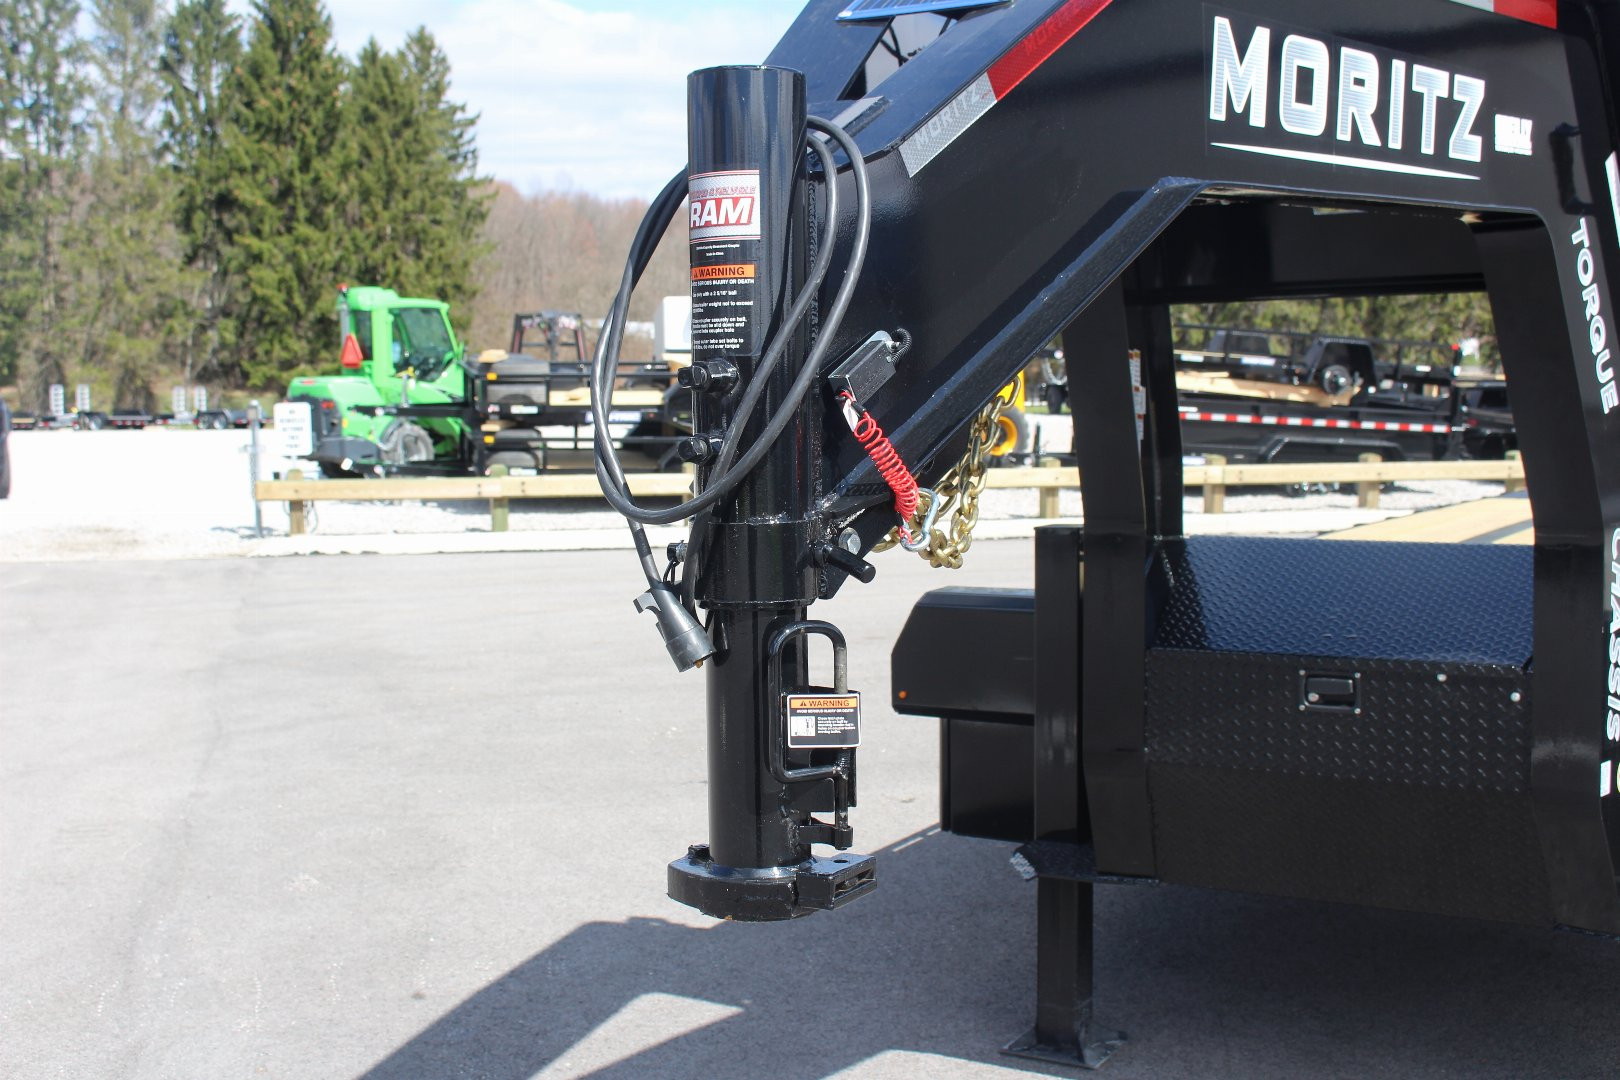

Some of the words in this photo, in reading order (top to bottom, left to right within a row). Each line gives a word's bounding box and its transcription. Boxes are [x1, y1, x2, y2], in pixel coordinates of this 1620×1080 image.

[1209, 15, 1486, 162] MORITZ
[691, 197, 753, 228] RAM
[699, 266, 745, 278] WARNING
[1571, 216, 1619, 415] TORQUE
[809, 699, 849, 707] WARNING
